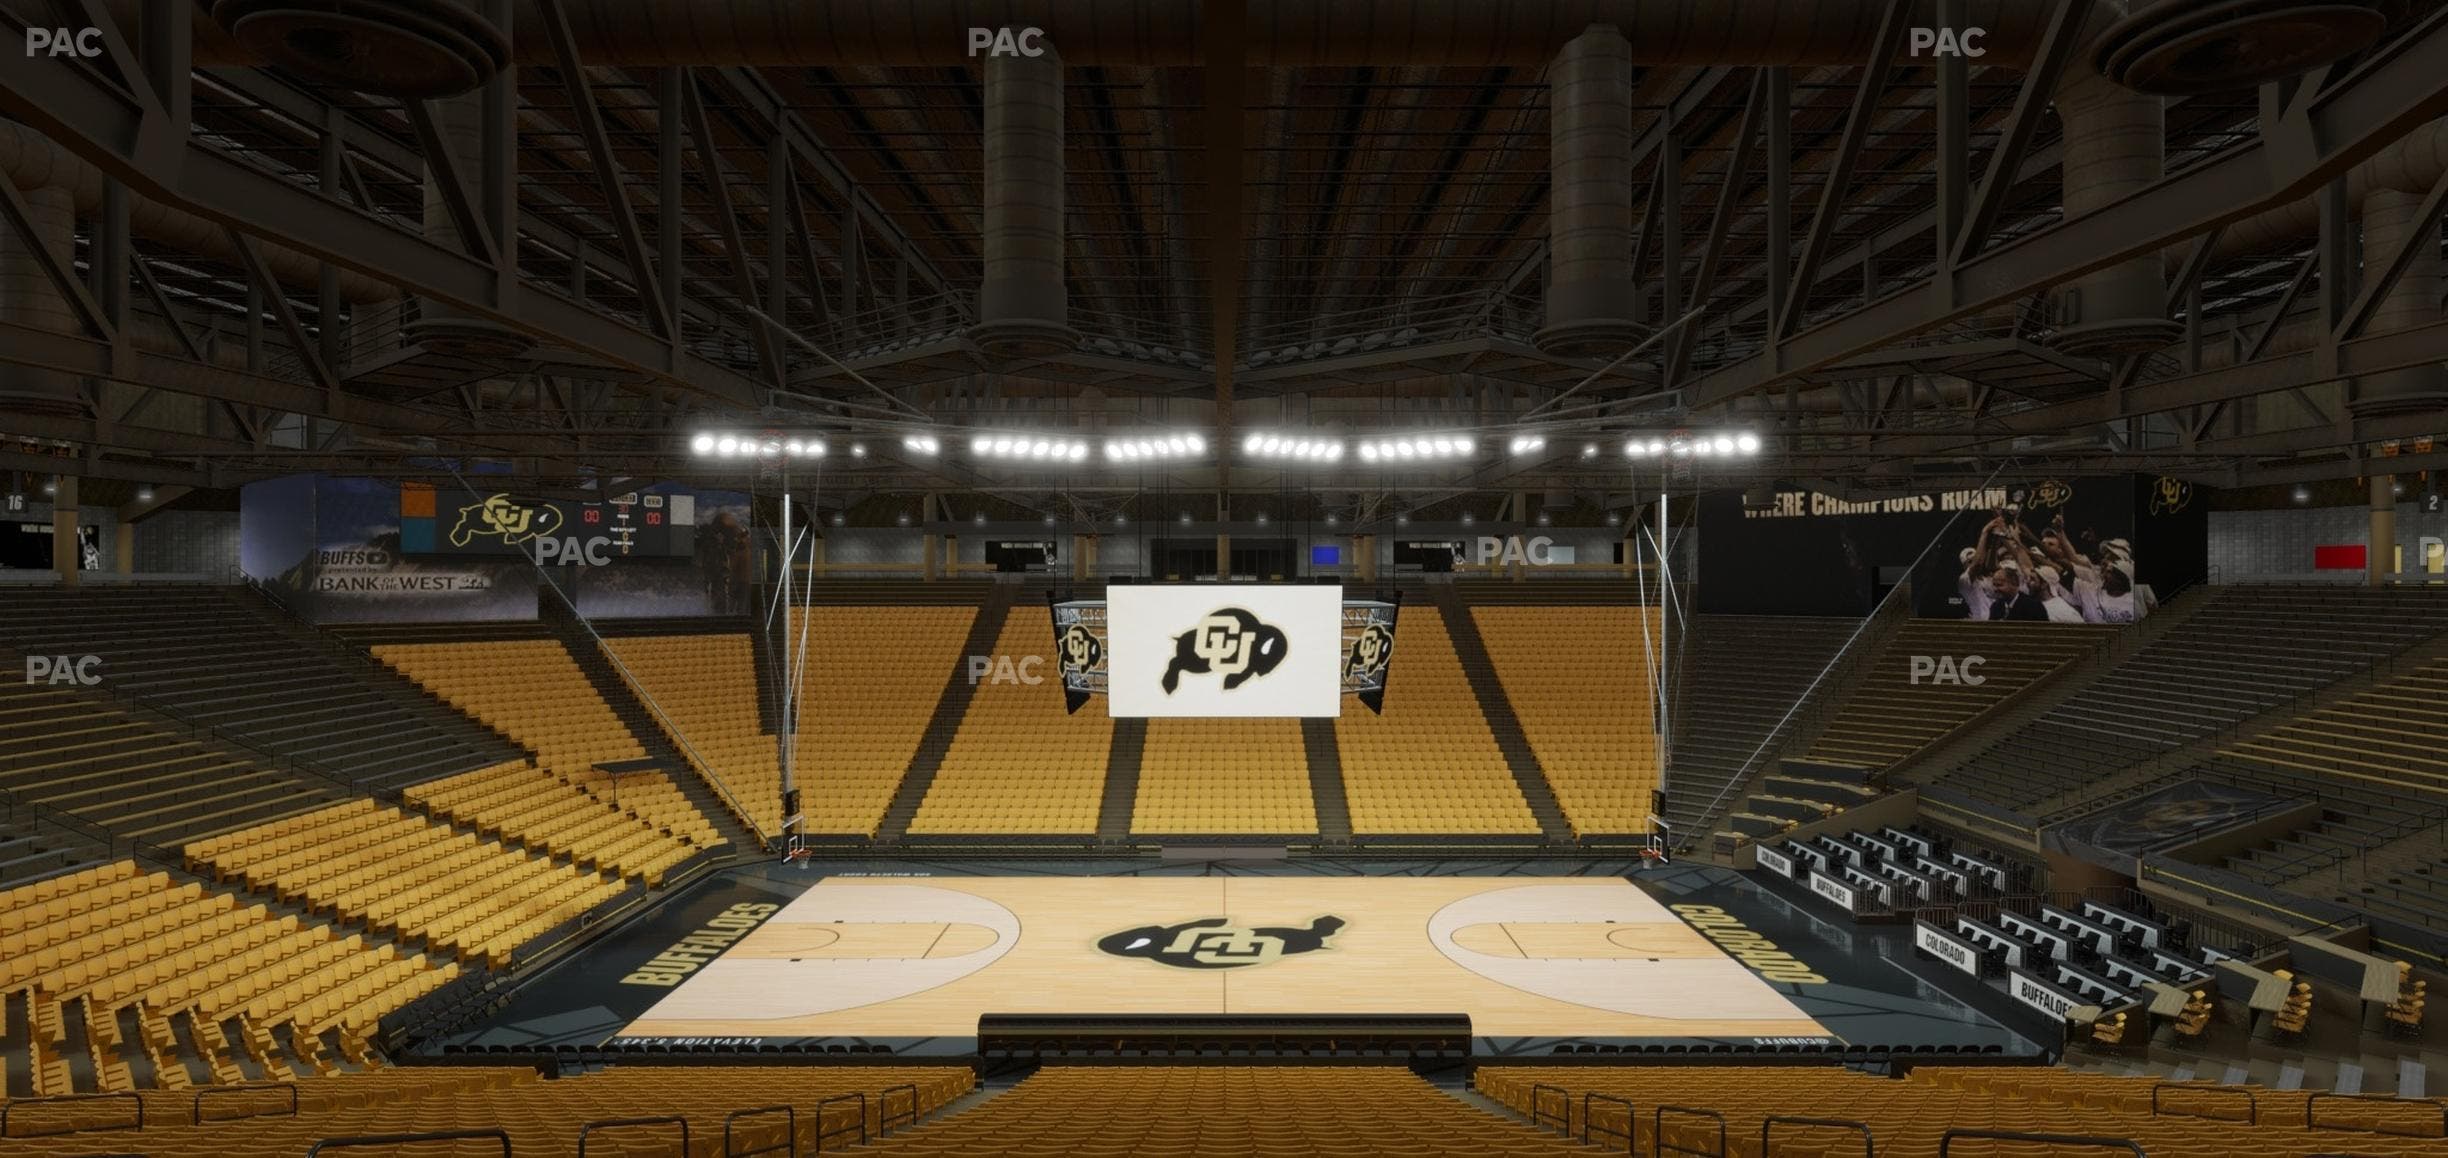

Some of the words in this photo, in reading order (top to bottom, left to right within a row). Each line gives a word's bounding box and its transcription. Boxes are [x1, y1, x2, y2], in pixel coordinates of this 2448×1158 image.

[8, 495, 23, 511] 16
[1742, 492, 1806, 518] ERE
[2428, 495, 2439, 511] 2
[584, 510, 600, 523] 00
[646, 512, 661, 525] 00
[320, 551, 366, 565] BUFFS
[319, 577, 379, 592] BANK
[399, 577, 456, 591] WEST
[1194, 615, 1255, 673] CU
[1816, 877, 1846, 903] BUFFALOES
[619, 902, 779, 986] BUFFALOES
[1669, 904, 1829, 984] COLORADO
[1925, 933, 1965, 965] COLORADO
[673, 1037, 763, 1045] ELEVATION
